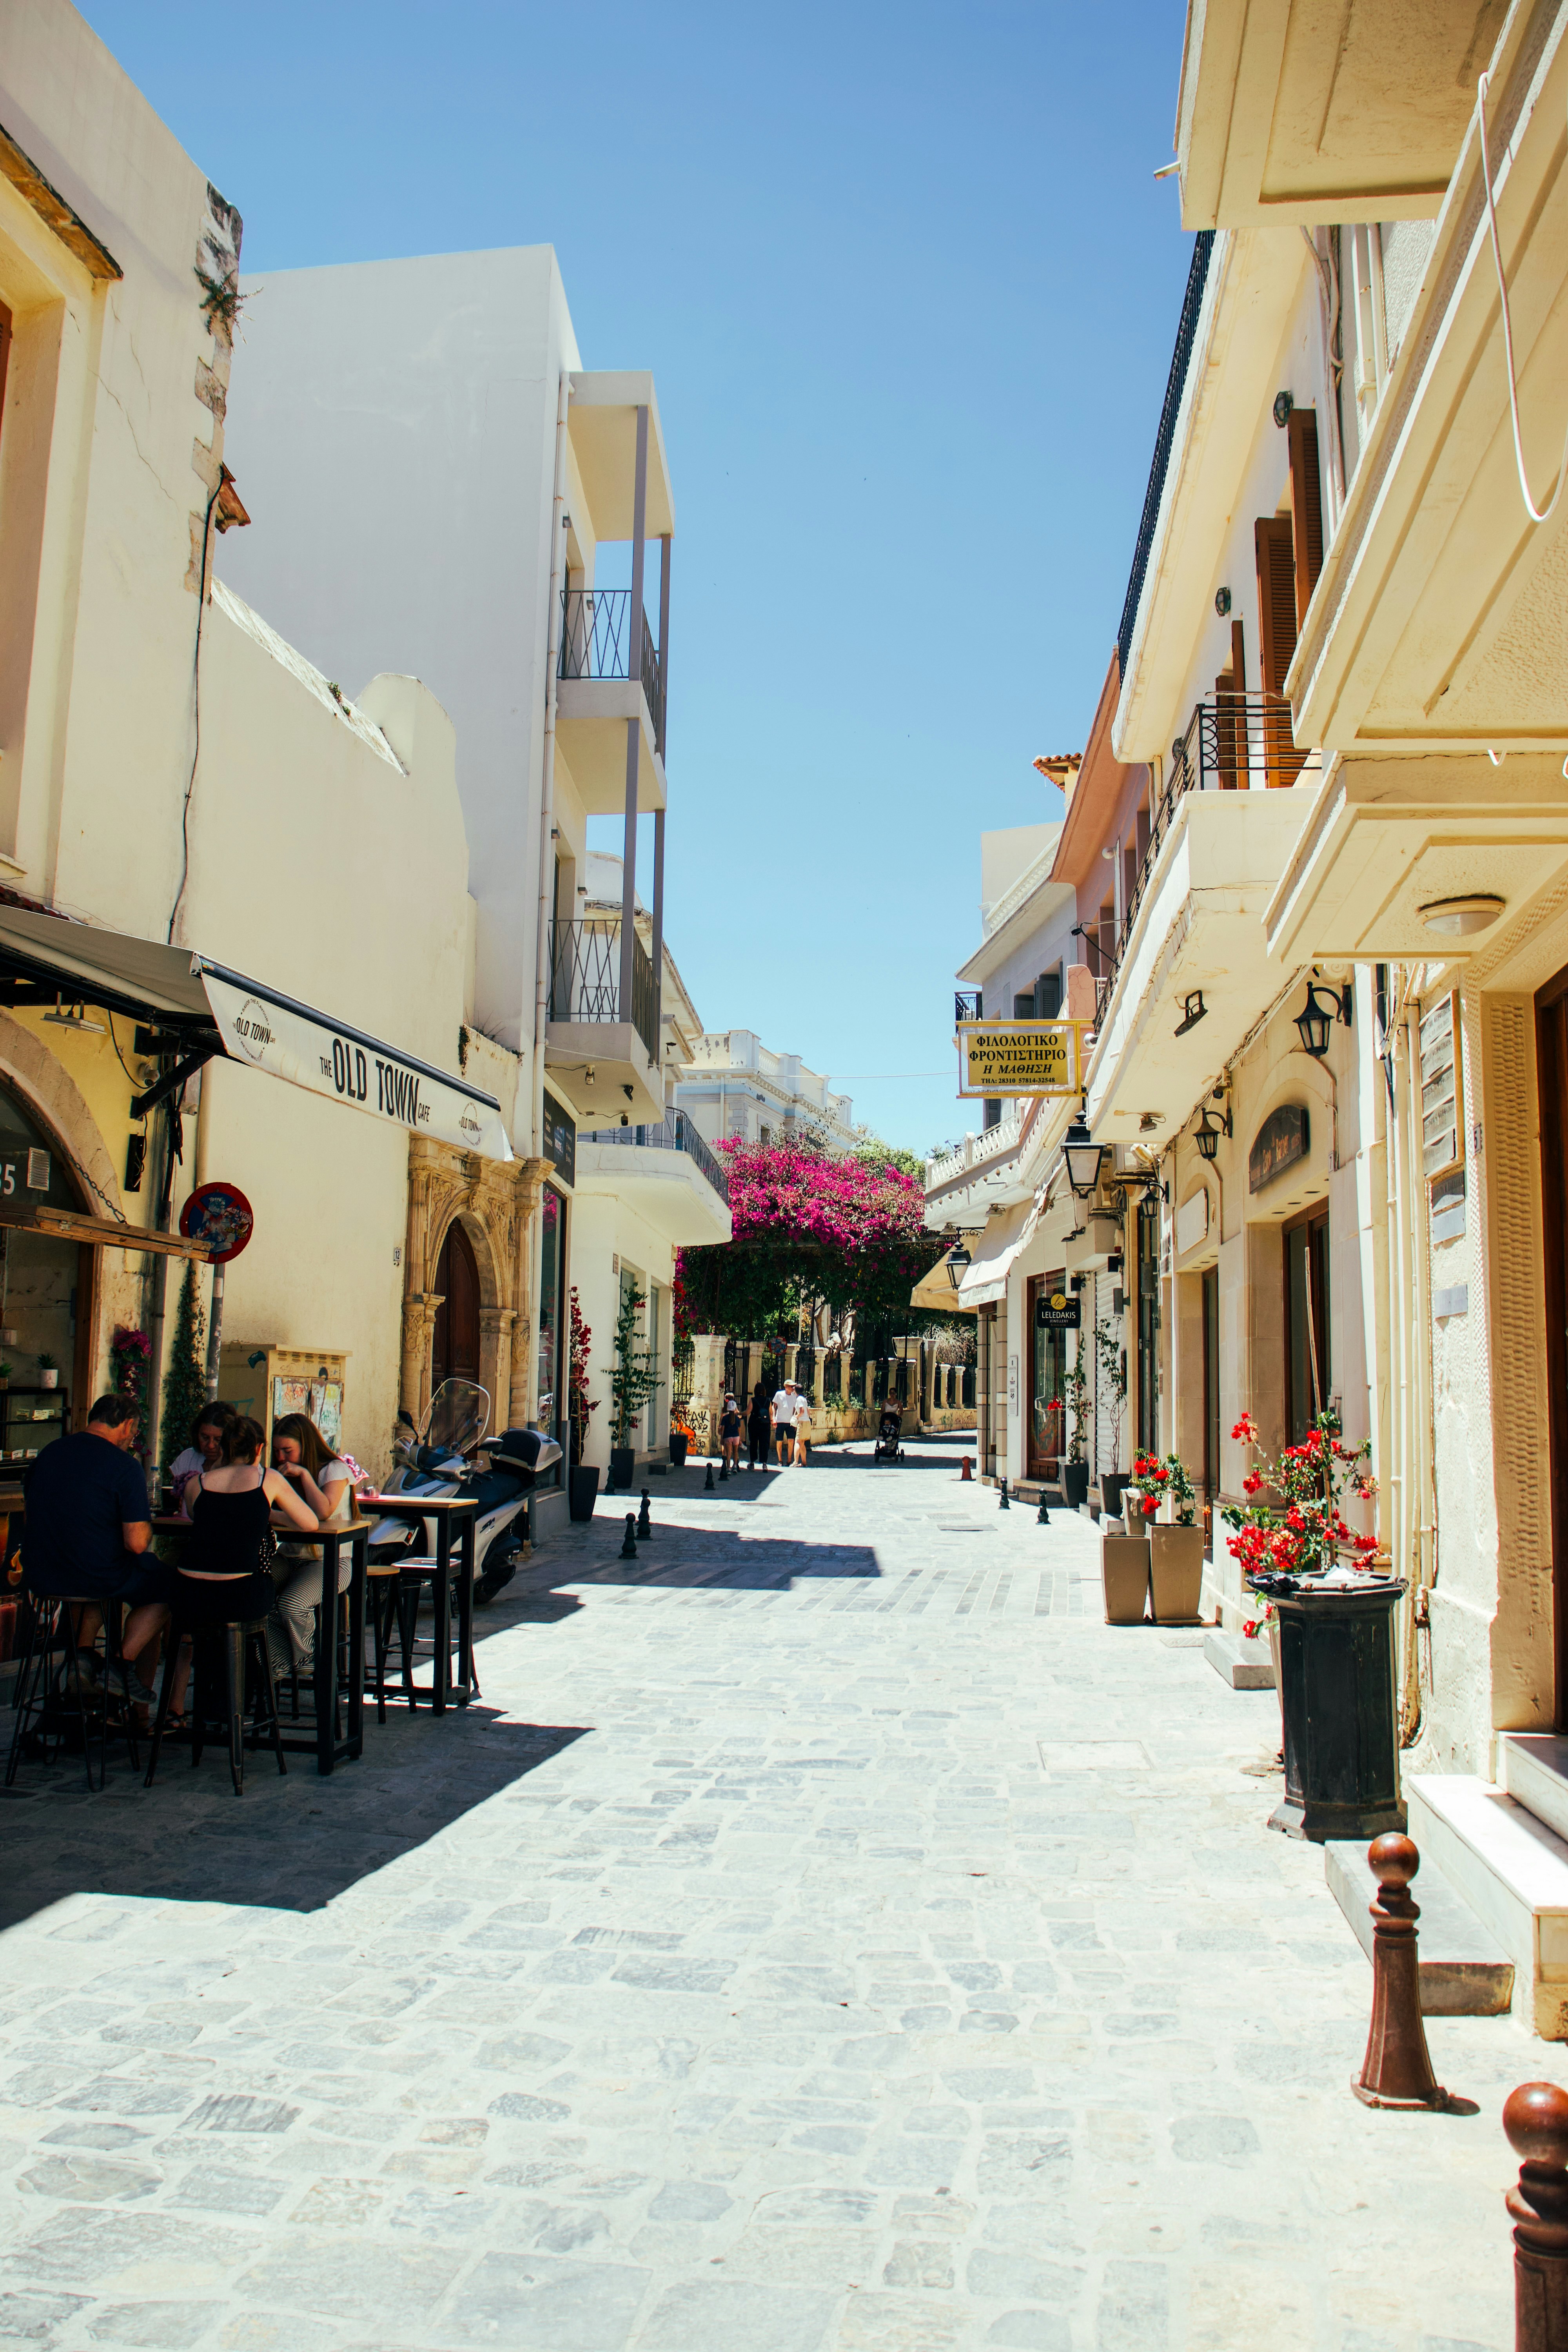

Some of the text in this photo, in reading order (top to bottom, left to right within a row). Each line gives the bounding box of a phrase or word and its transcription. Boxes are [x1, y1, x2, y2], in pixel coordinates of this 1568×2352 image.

[236, 1017, 250, 1036] OLD
[250, 1023, 271, 1044] TOWN
[976, 1035, 1058, 1046] ΦΙΛΟΛΟΓΙΚΟ
[969, 1049, 1066, 1061] ΦΡΟΝΤΙΣΤΗΡΙΟ
[983, 1064, 1052, 1074] Η ΜΑΘΗΣΗ
[319, 1038, 430, 1126] THE OLD TOWN CAFE
[468, 1119, 479, 1132] TOWN
[0, 1163, 15, 1195] 5
[395, 1250, 400, 1259] 12
